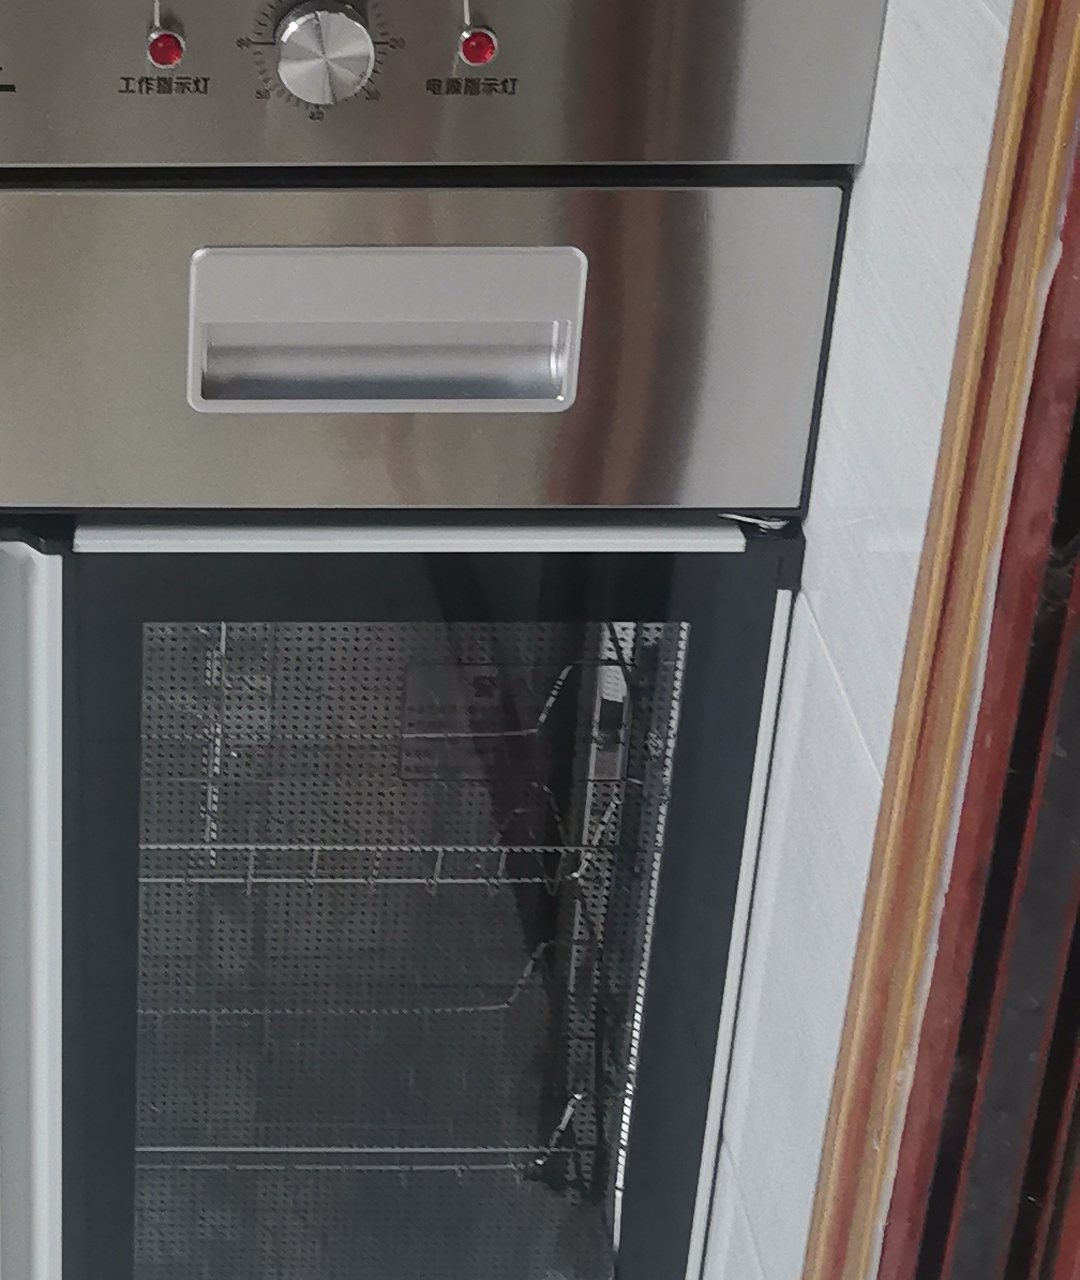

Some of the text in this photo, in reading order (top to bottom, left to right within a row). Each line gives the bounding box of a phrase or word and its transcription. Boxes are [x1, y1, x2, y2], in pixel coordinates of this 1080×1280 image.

[118, 75, 211, 95] 工作指示灯
